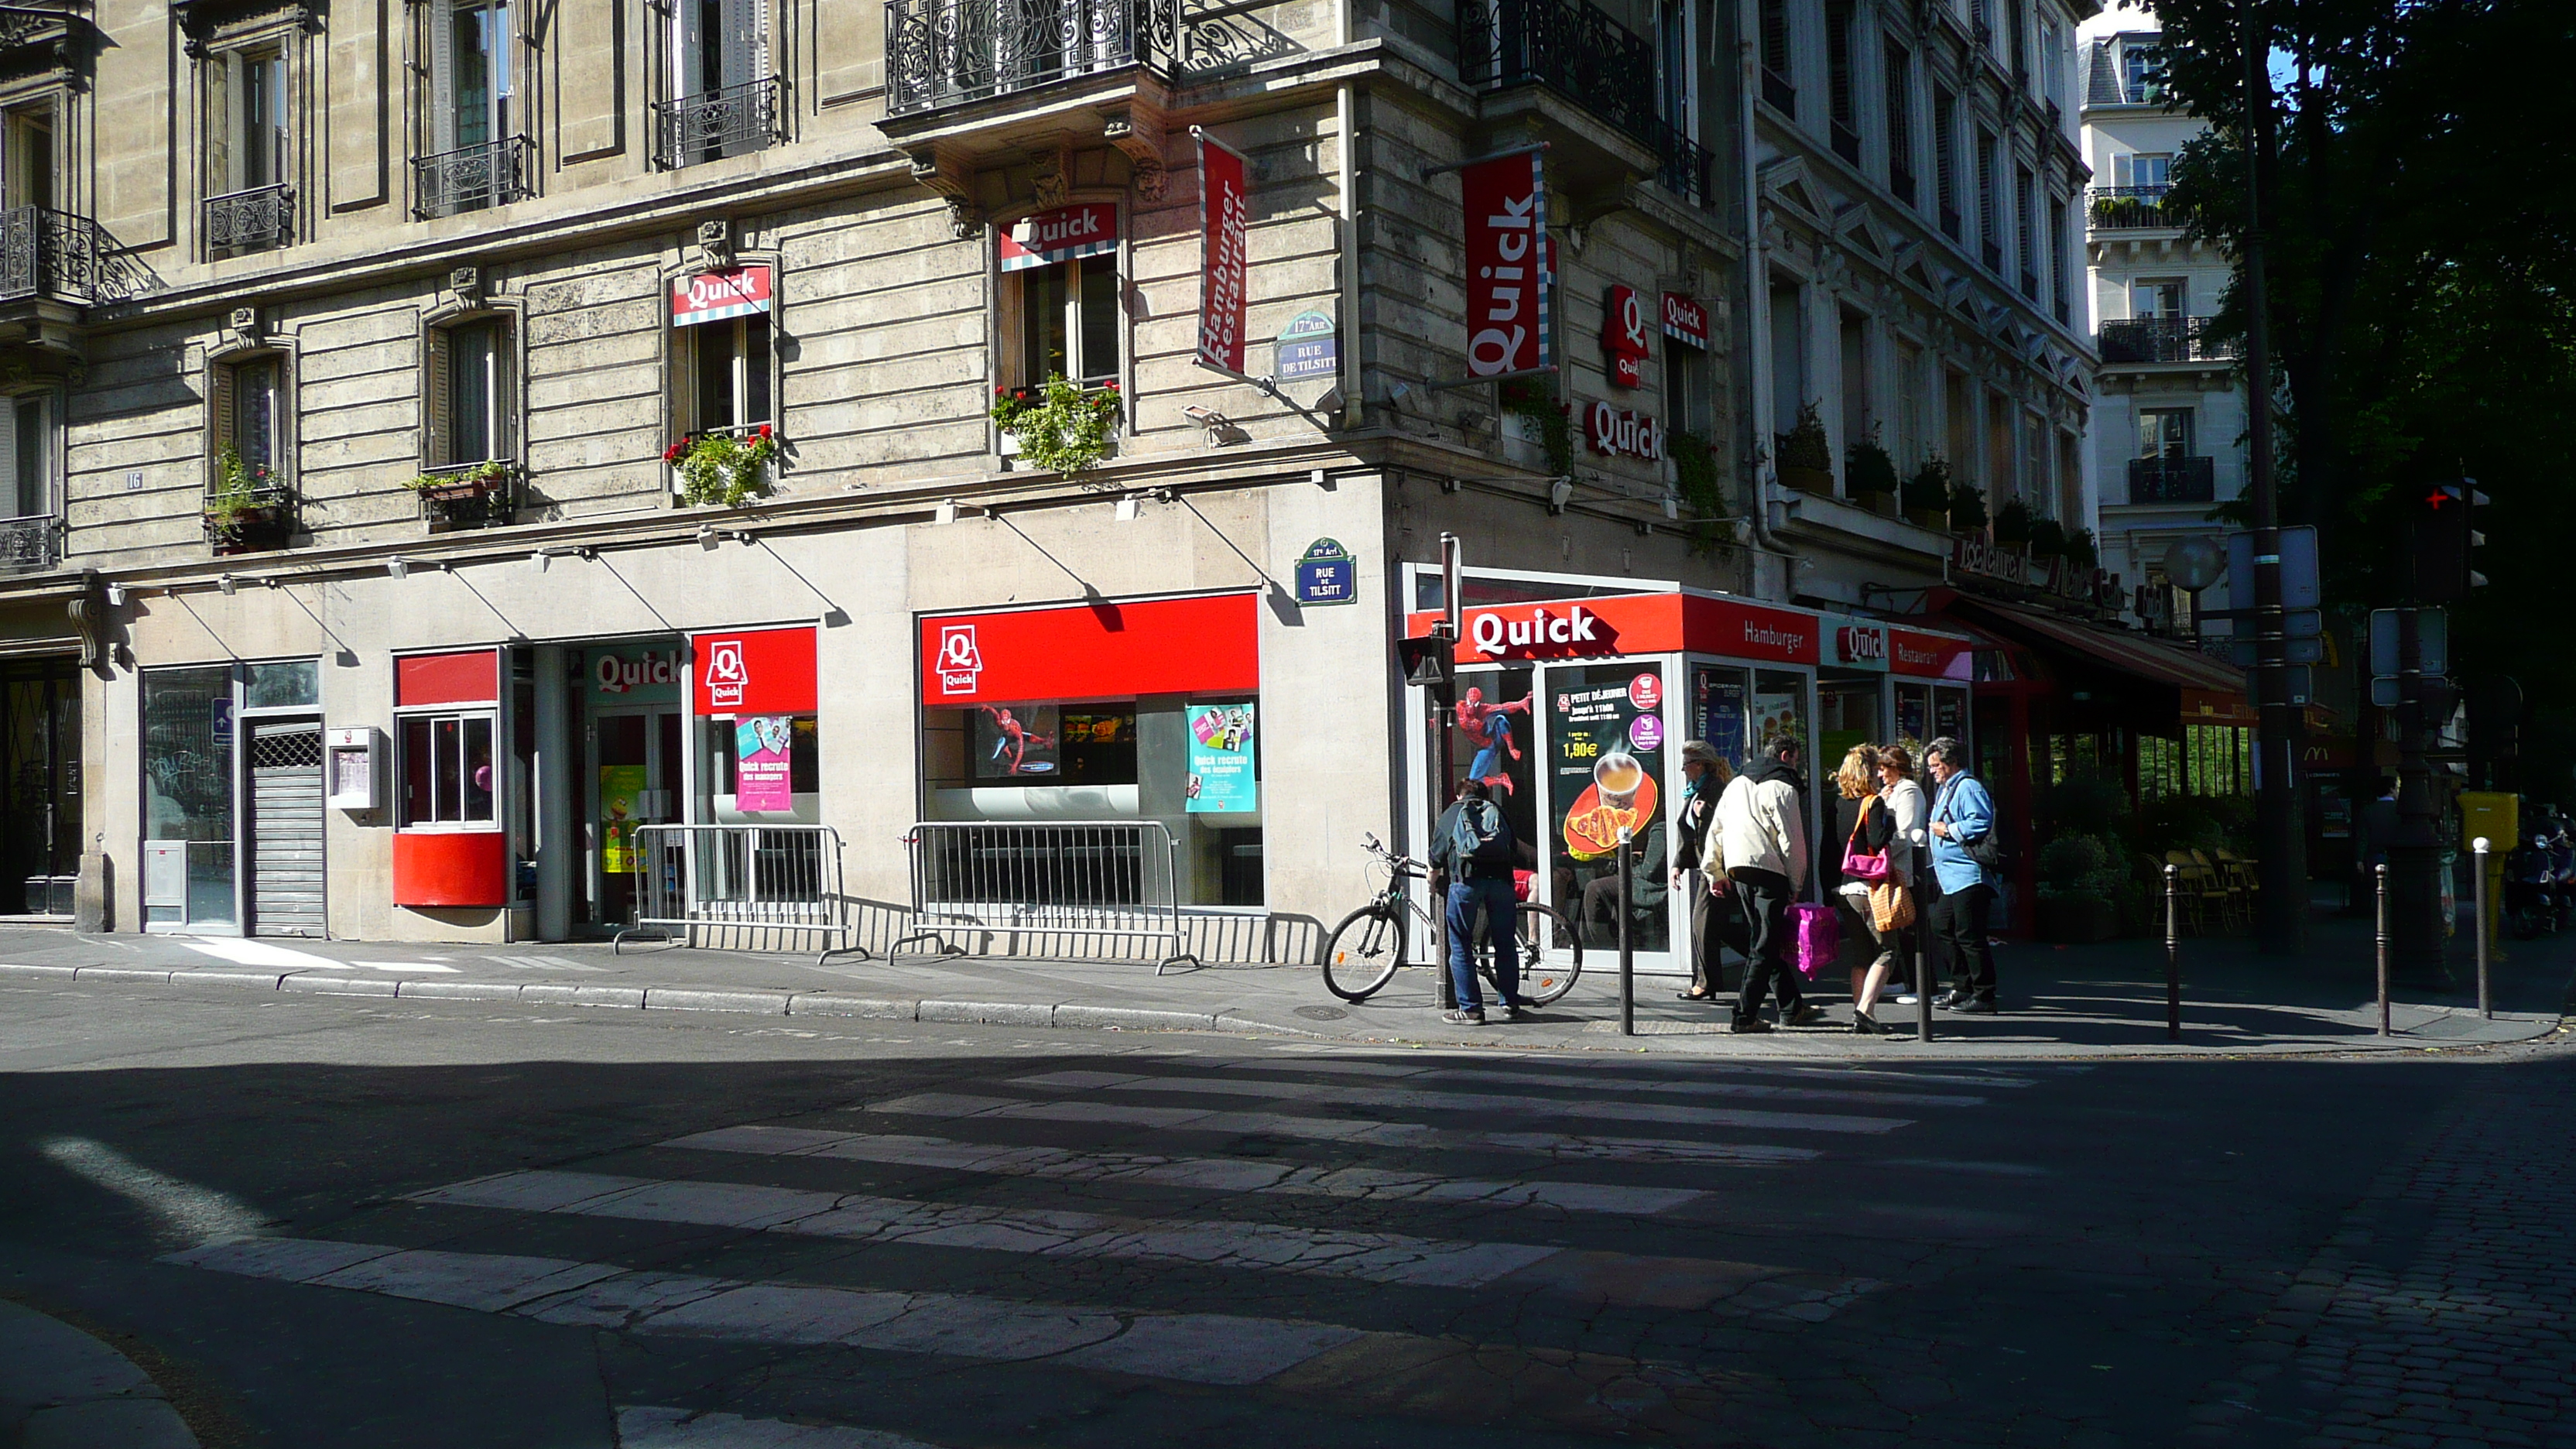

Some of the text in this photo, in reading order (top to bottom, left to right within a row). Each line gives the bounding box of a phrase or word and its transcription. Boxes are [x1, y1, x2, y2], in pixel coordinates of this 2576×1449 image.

[1020, 207, 1099, 252] Quick
[1200, 180, 1235, 361] Hamburger
[1214, 194, 1245, 370] Restaurant
[687, 269, 756, 310] Quick
[1468, 194, 1534, 377] Quick
[1667, 296, 1701, 331] Quick
[1297, 345, 1322, 358] RUE
[1283, 356, 1336, 374] DE TILSITT
[1595, 400, 1663, 461] Quick
[129, 473, 140, 488] 16
[1315, 567, 1335, 579] RUE
[1309, 584, 1341, 597] TILSITT
[1472, 605, 1597, 655] Quick
[1744, 619, 1804, 655] Hamburger
[1848, 625, 1887, 662] Quick
[1897, 642, 1938, 665] Restaurant
[596, 649, 683, 693] Quick
[947, 673, 973, 687] Quick
[715, 687, 739, 698] Quick
[1570, 688, 1628, 704] PETIT DÉJEUNER
[1194, 755, 1248, 766] Quick recrute
[1563, 742, 1598, 759] 1,90€
[738, 761, 789, 772] Quick recrute
